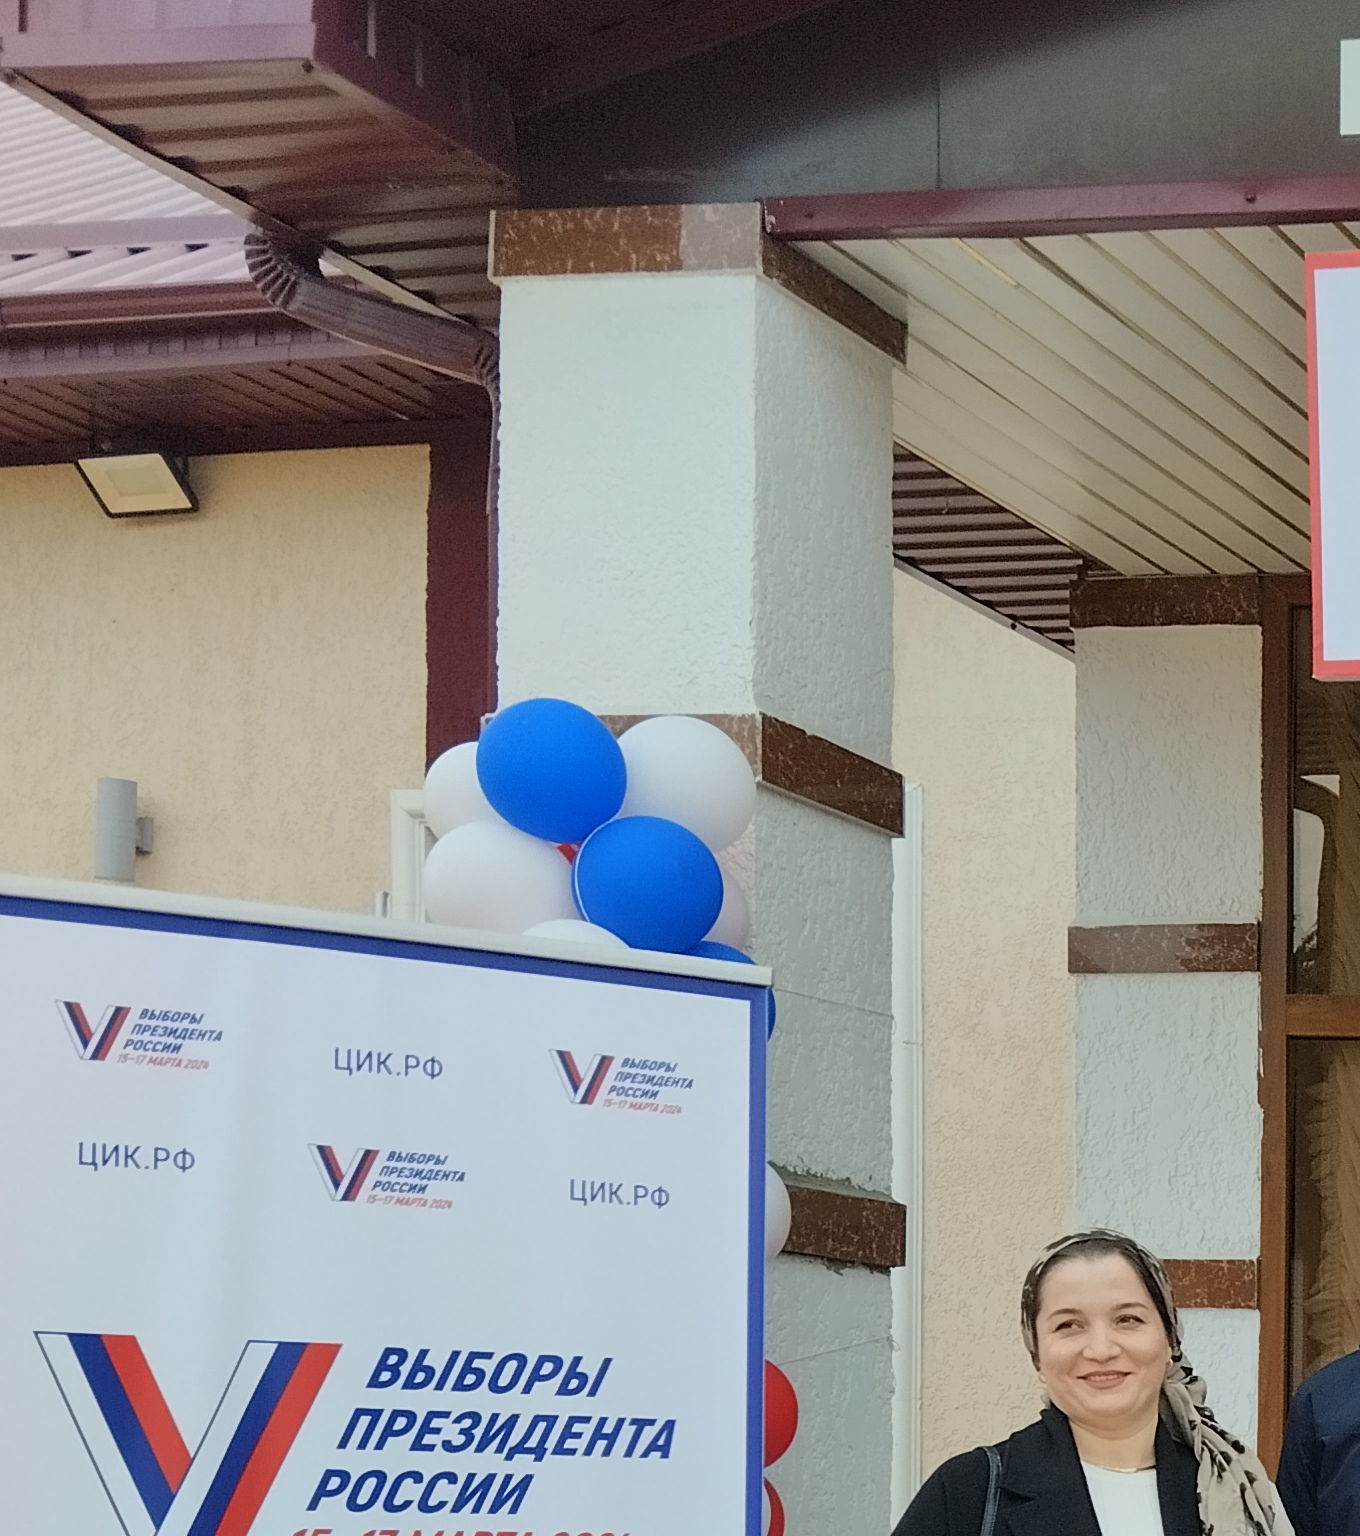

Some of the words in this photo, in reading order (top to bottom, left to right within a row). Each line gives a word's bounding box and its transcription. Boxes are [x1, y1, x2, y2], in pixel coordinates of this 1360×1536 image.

[139, 1008, 204, 1026] ВЫБОРЫ
[131, 1023, 222, 1043] ПРЕЗИДЕНТА
[123, 1038, 184, 1055] РОССИИ
[147, 1055, 183, 1068] МАРТА
[183, 1058, 209, 1070] 2024
[335, 1047, 442, 1079] ЦИК.РФ
[621, 1057, 678, 1074] ВЫБОРЫ
[614, 1071, 693, 1090] ПРЕЗИДЕНТА
[608, 1084, 660, 1100] РОССИИ
[628, 1100, 660, 1113] МАРТА
[659, 1104, 682, 1115] 2024
[79, 1142, 195, 1173] ЦИК.РФ
[386, 1151, 448, 1167] ВЫБОРЫ
[379, 1165, 465, 1183] ПРЕЗИДЕНТА
[372, 1180, 429, 1195] РОССИИ
[570, 1179, 669, 1209] ЦИК.РФ
[394, 1196, 428, 1208] МАРТА
[428, 1198, 452, 1209] 2024
[366, 1347, 613, 1397] ВЫБОРЫ
[336, 1408, 676, 1462] ПРЕЗИДЕНТА
[306, 1469, 535, 1515] РОССИИ
